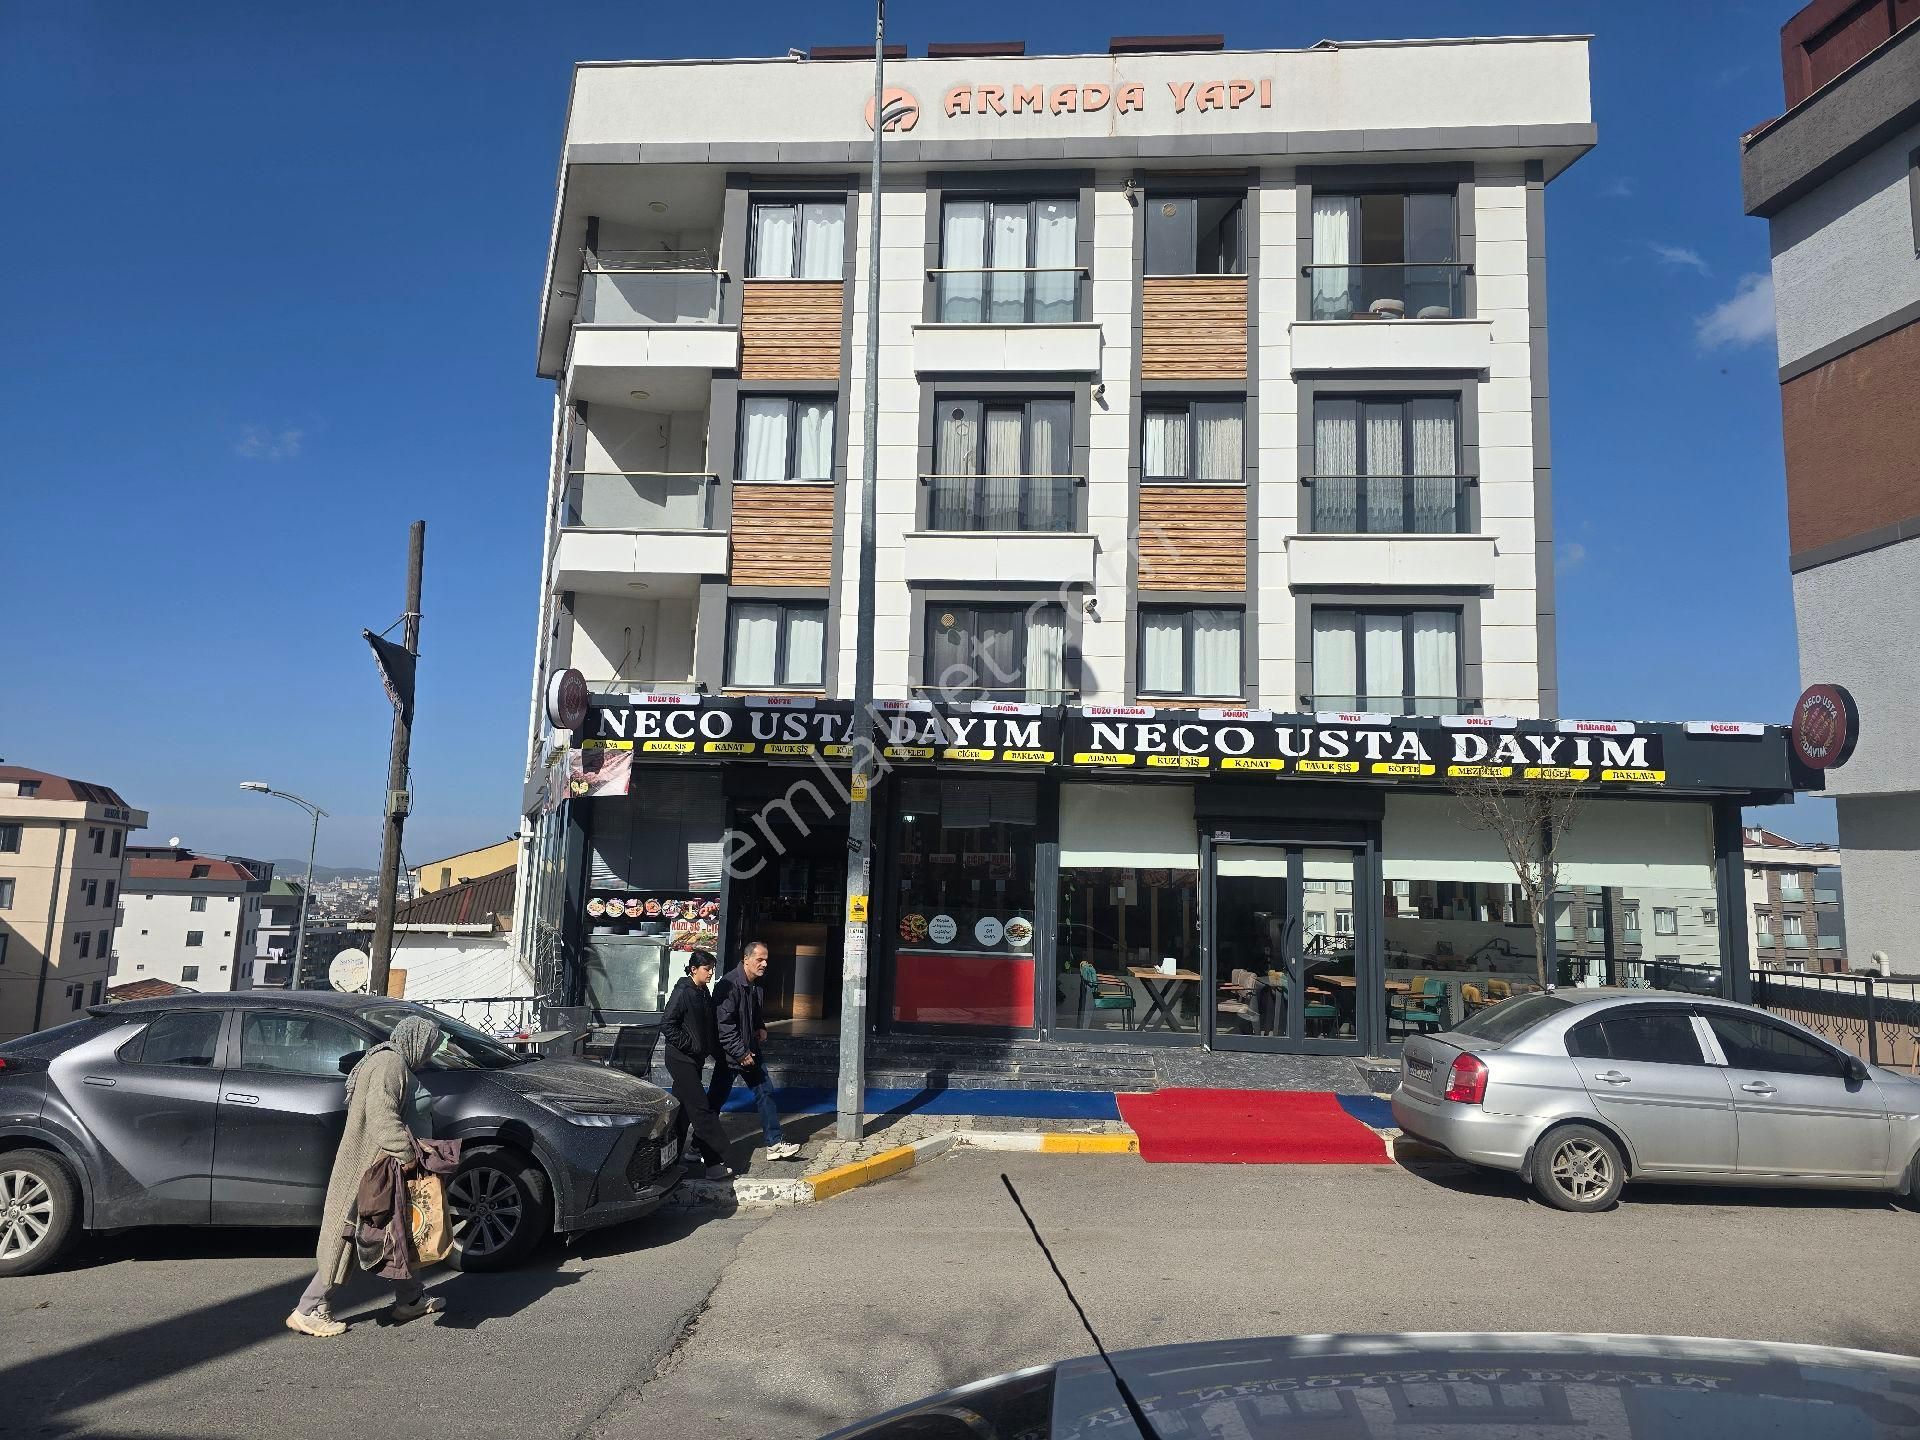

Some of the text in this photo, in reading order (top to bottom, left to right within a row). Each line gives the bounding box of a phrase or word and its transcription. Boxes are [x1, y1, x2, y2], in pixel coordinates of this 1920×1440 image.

[943, 78, 1272, 118] ARMADA YAPI
[1803, 695, 1838, 720] NECO USTA
[597, 708, 733, 739] NECO
[887, 716, 1042, 748] DAYIM
[714, 743, 745, 752] KANAT
[770, 744, 795, 753] TAVUK
[1090, 721, 1650, 767] NECO USTA DAYIM
[1803, 741, 1828, 758] DAYIM
[1011, 752, 1046, 761] BAKLAVA
[1087, 754, 1118, 763] ADANA
[1234, 759, 1272, 769] KANAT
[1304, 761, 1335, 770] TAVUK
[1611, 770, 1657, 781] BAKLAVA
